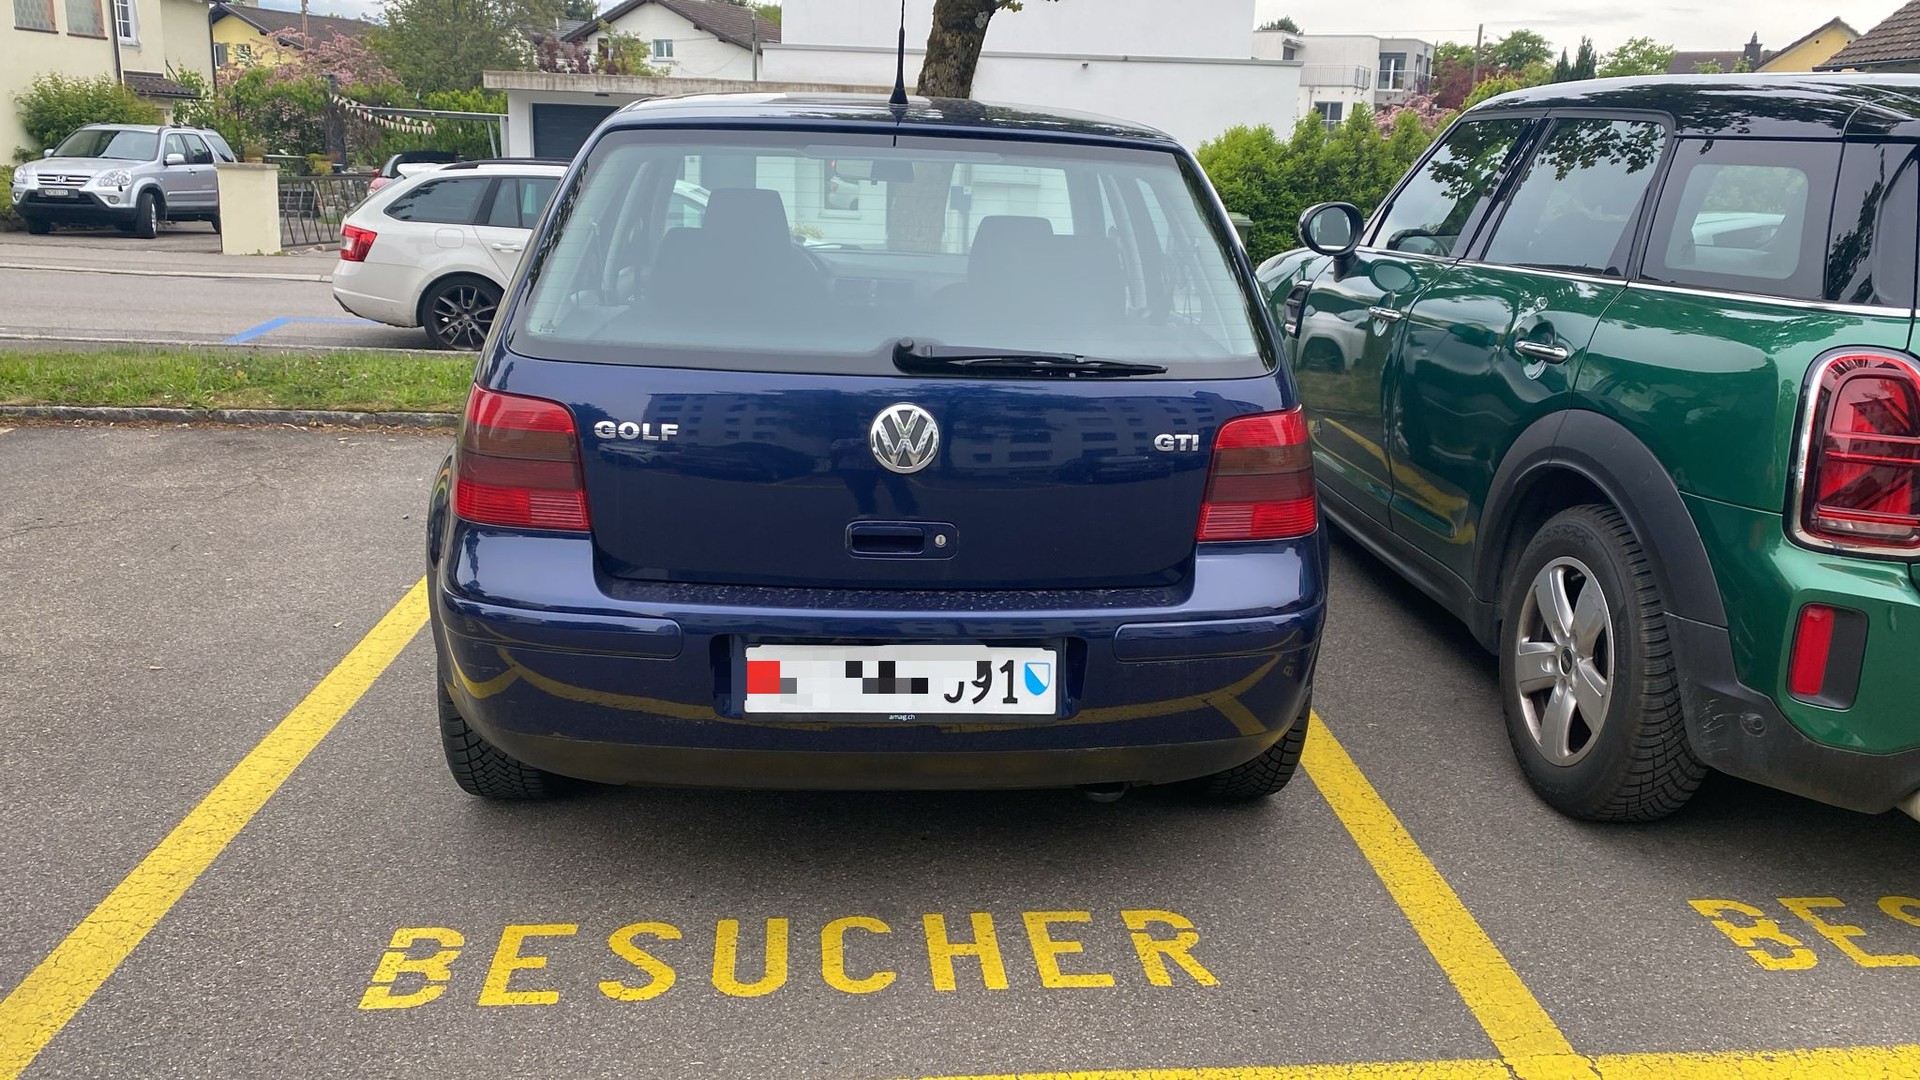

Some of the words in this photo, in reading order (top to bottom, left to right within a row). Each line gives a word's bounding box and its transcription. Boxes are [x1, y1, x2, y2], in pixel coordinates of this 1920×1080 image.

[593, 420, 679, 441] GOLF
[1153, 433, 1200, 452] GTI
[889, 713, 916, 722] amag.ch
[359, 909, 1221, 1010] BESUCHER
